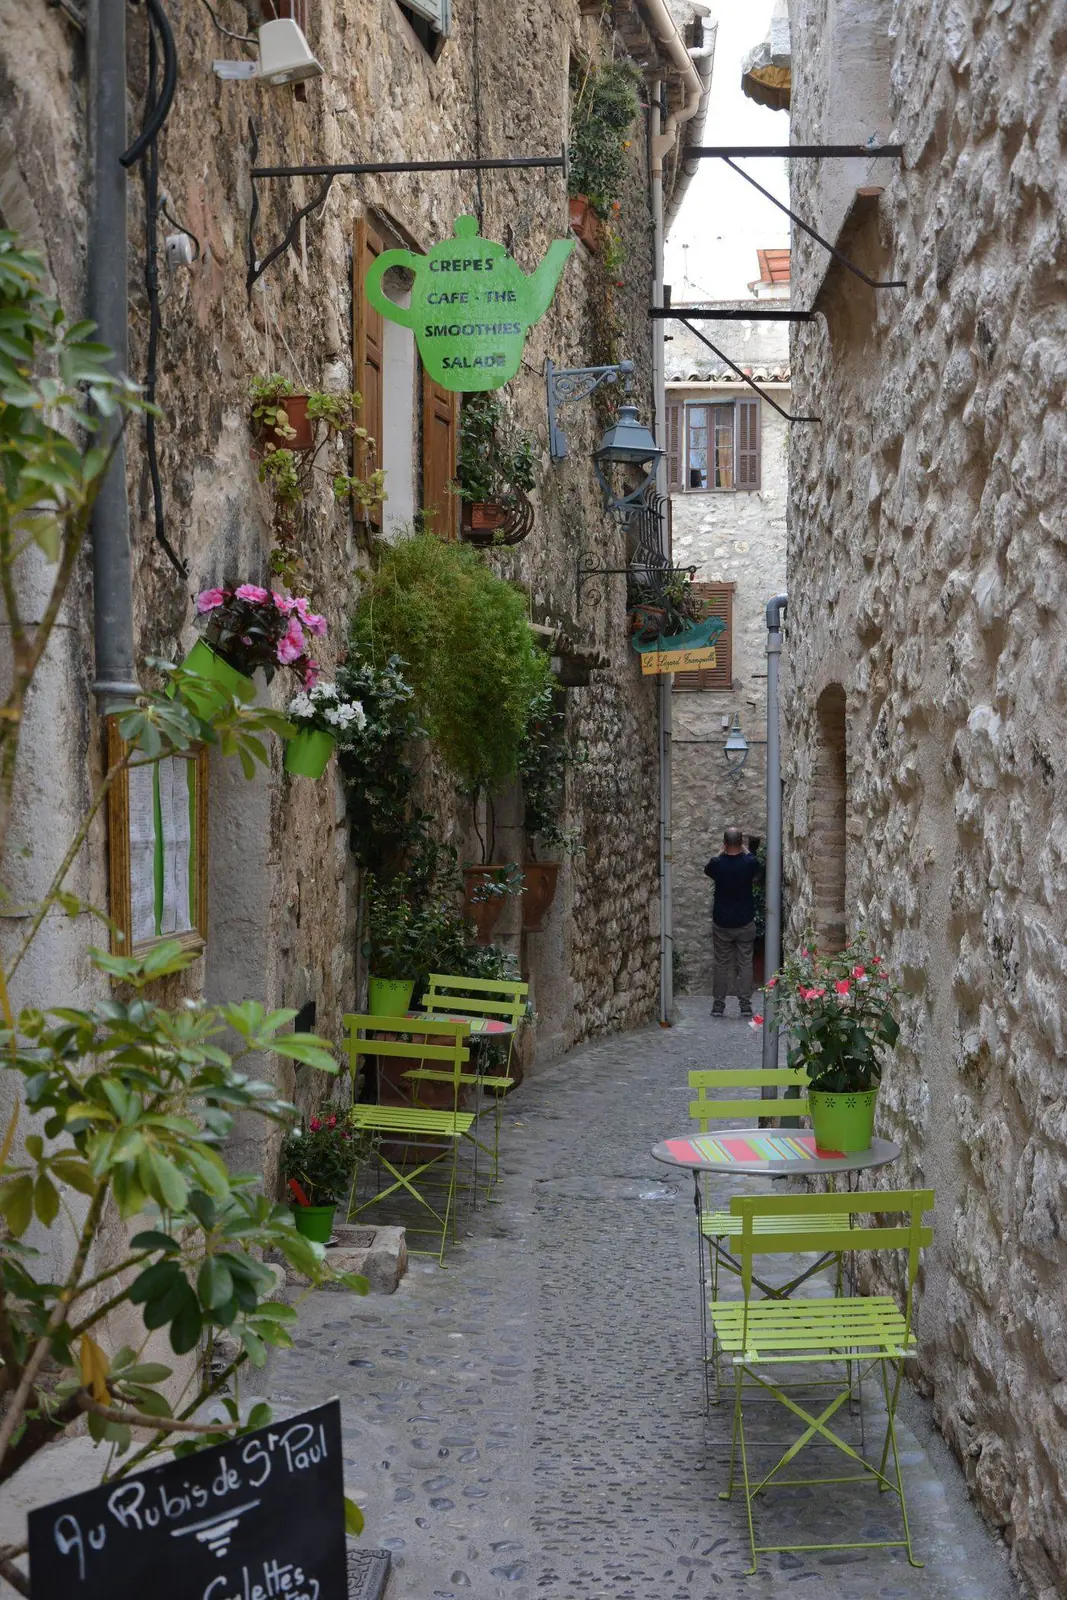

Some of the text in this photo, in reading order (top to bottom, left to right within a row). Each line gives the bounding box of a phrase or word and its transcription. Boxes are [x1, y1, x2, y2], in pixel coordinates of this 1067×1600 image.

[429, 258, 494, 272] CREPES
[427, 291, 517, 305] CAFE THE
[425, 322, 521, 337] SMOOTHIES
[442, 355, 506, 369] SALADE
[54, 1514, 106, 1580] Au
[108, 1481, 209, 1530] Rubis
[212, 1456, 240, 1496] de
[280, 1423, 328, 1473] Paul
